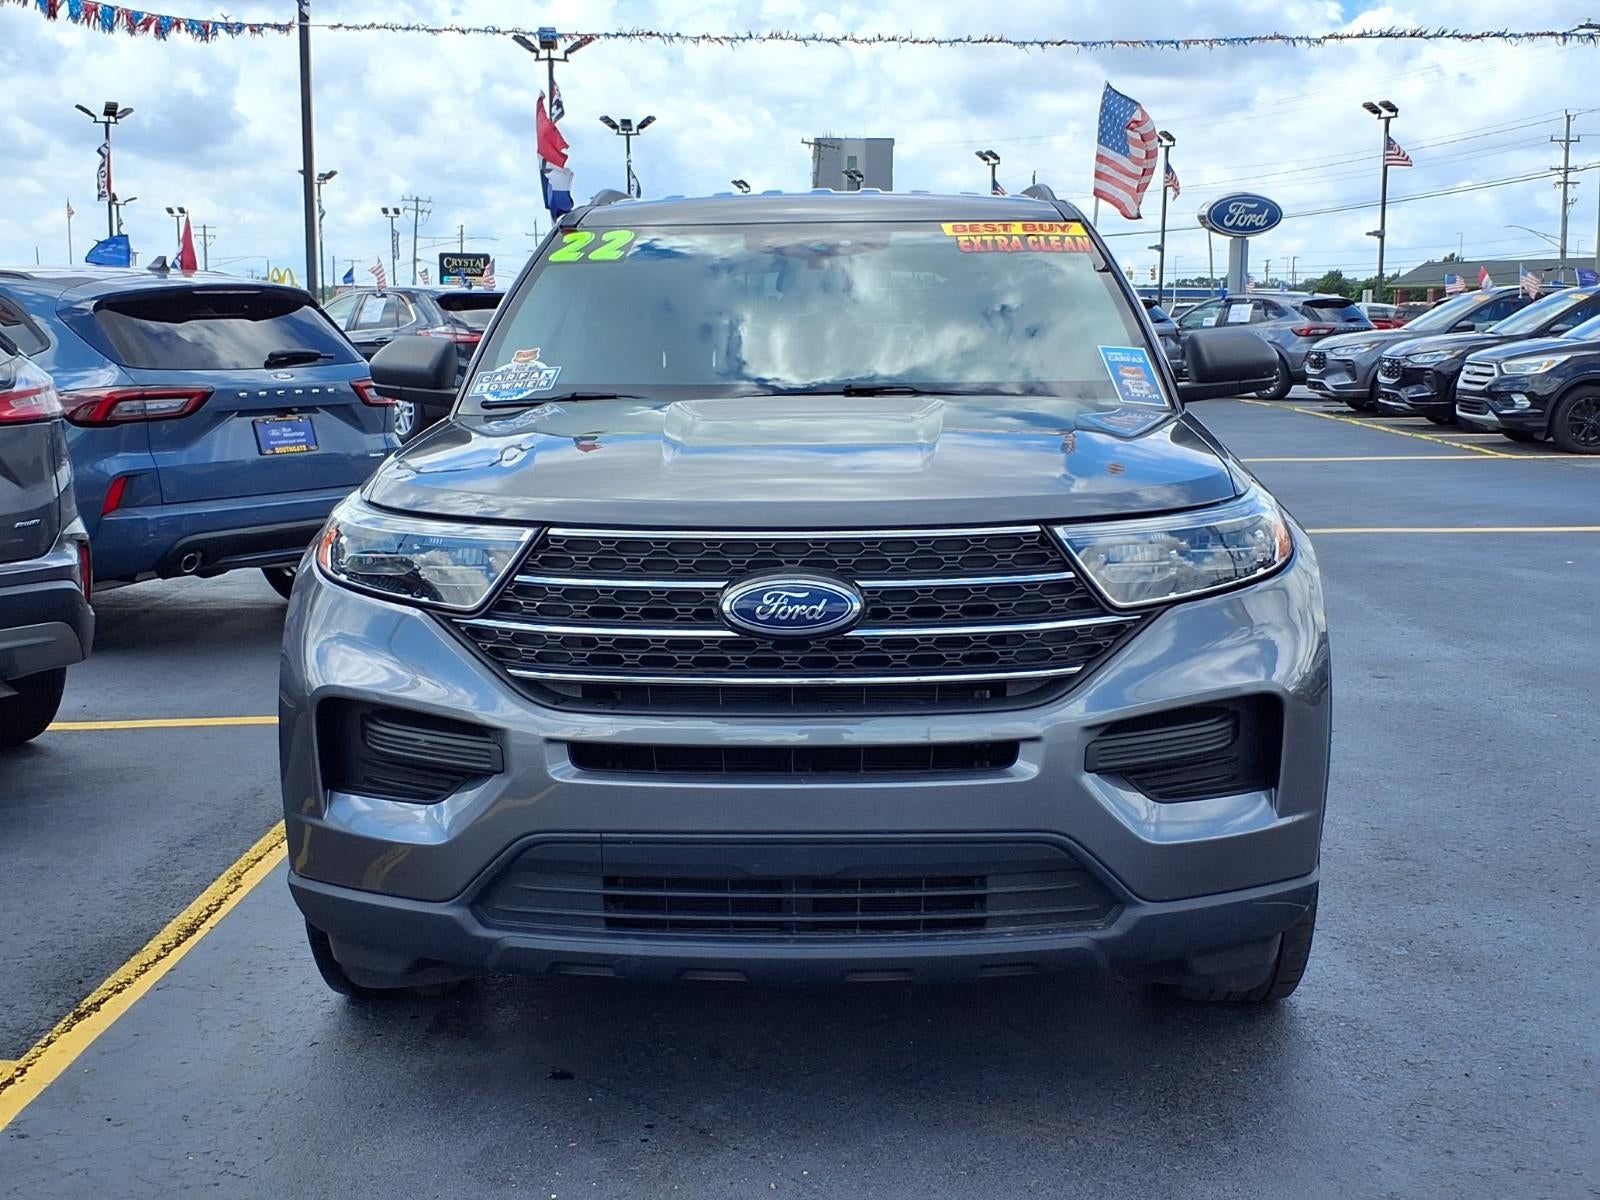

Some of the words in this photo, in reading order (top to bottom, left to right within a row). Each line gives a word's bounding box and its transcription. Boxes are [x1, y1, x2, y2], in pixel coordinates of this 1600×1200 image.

[1224, 202, 1269, 227] Ford
[952, 223, 1014, 234] BEST
[1022, 223, 1073, 234] BUY
[549, 229, 635, 262] 22
[957, 235, 1025, 253] EXTRA
[1027, 235, 1093, 253] CLEAN
[443, 256, 486, 269] CRYSTAL
[1107, 355, 1145, 363] CARFAX
[481, 371, 554, 383] CARFAX
[490, 379, 548, 391] OWNER
[275, 445, 307, 453] SOUTHGATE
[755, 590, 828, 621] Ford
